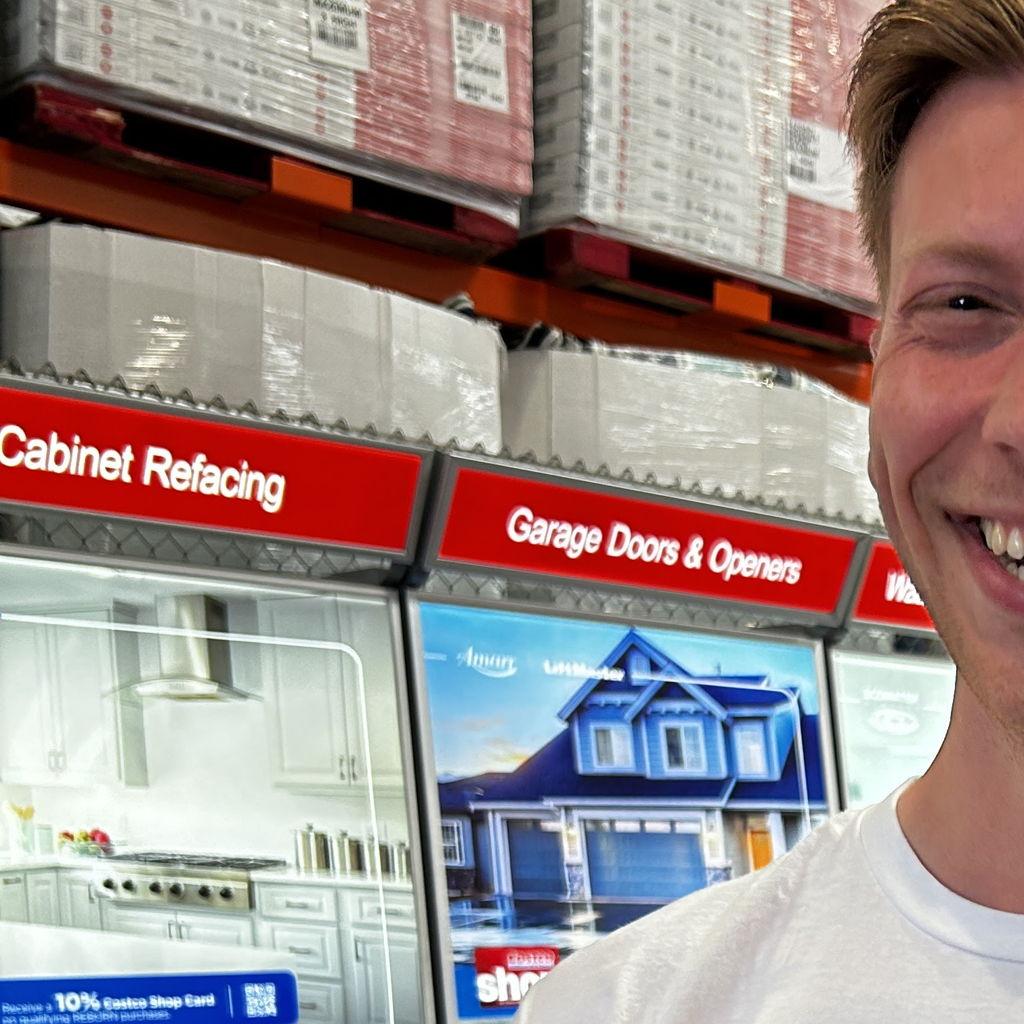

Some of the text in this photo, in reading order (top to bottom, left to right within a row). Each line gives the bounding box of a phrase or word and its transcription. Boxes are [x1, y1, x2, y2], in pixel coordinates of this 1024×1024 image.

[0, 424, 286, 514] Cabinet Refacing
[507, 505, 803, 584] Garage Doors & Openers
[885, 569, 925, 607] Wa
[54, 991, 101, 1013] 10%
[149, 994, 182, 1010] Shop
[184, 993, 215, 1008] Card
[477, 965, 550, 1003] sho
